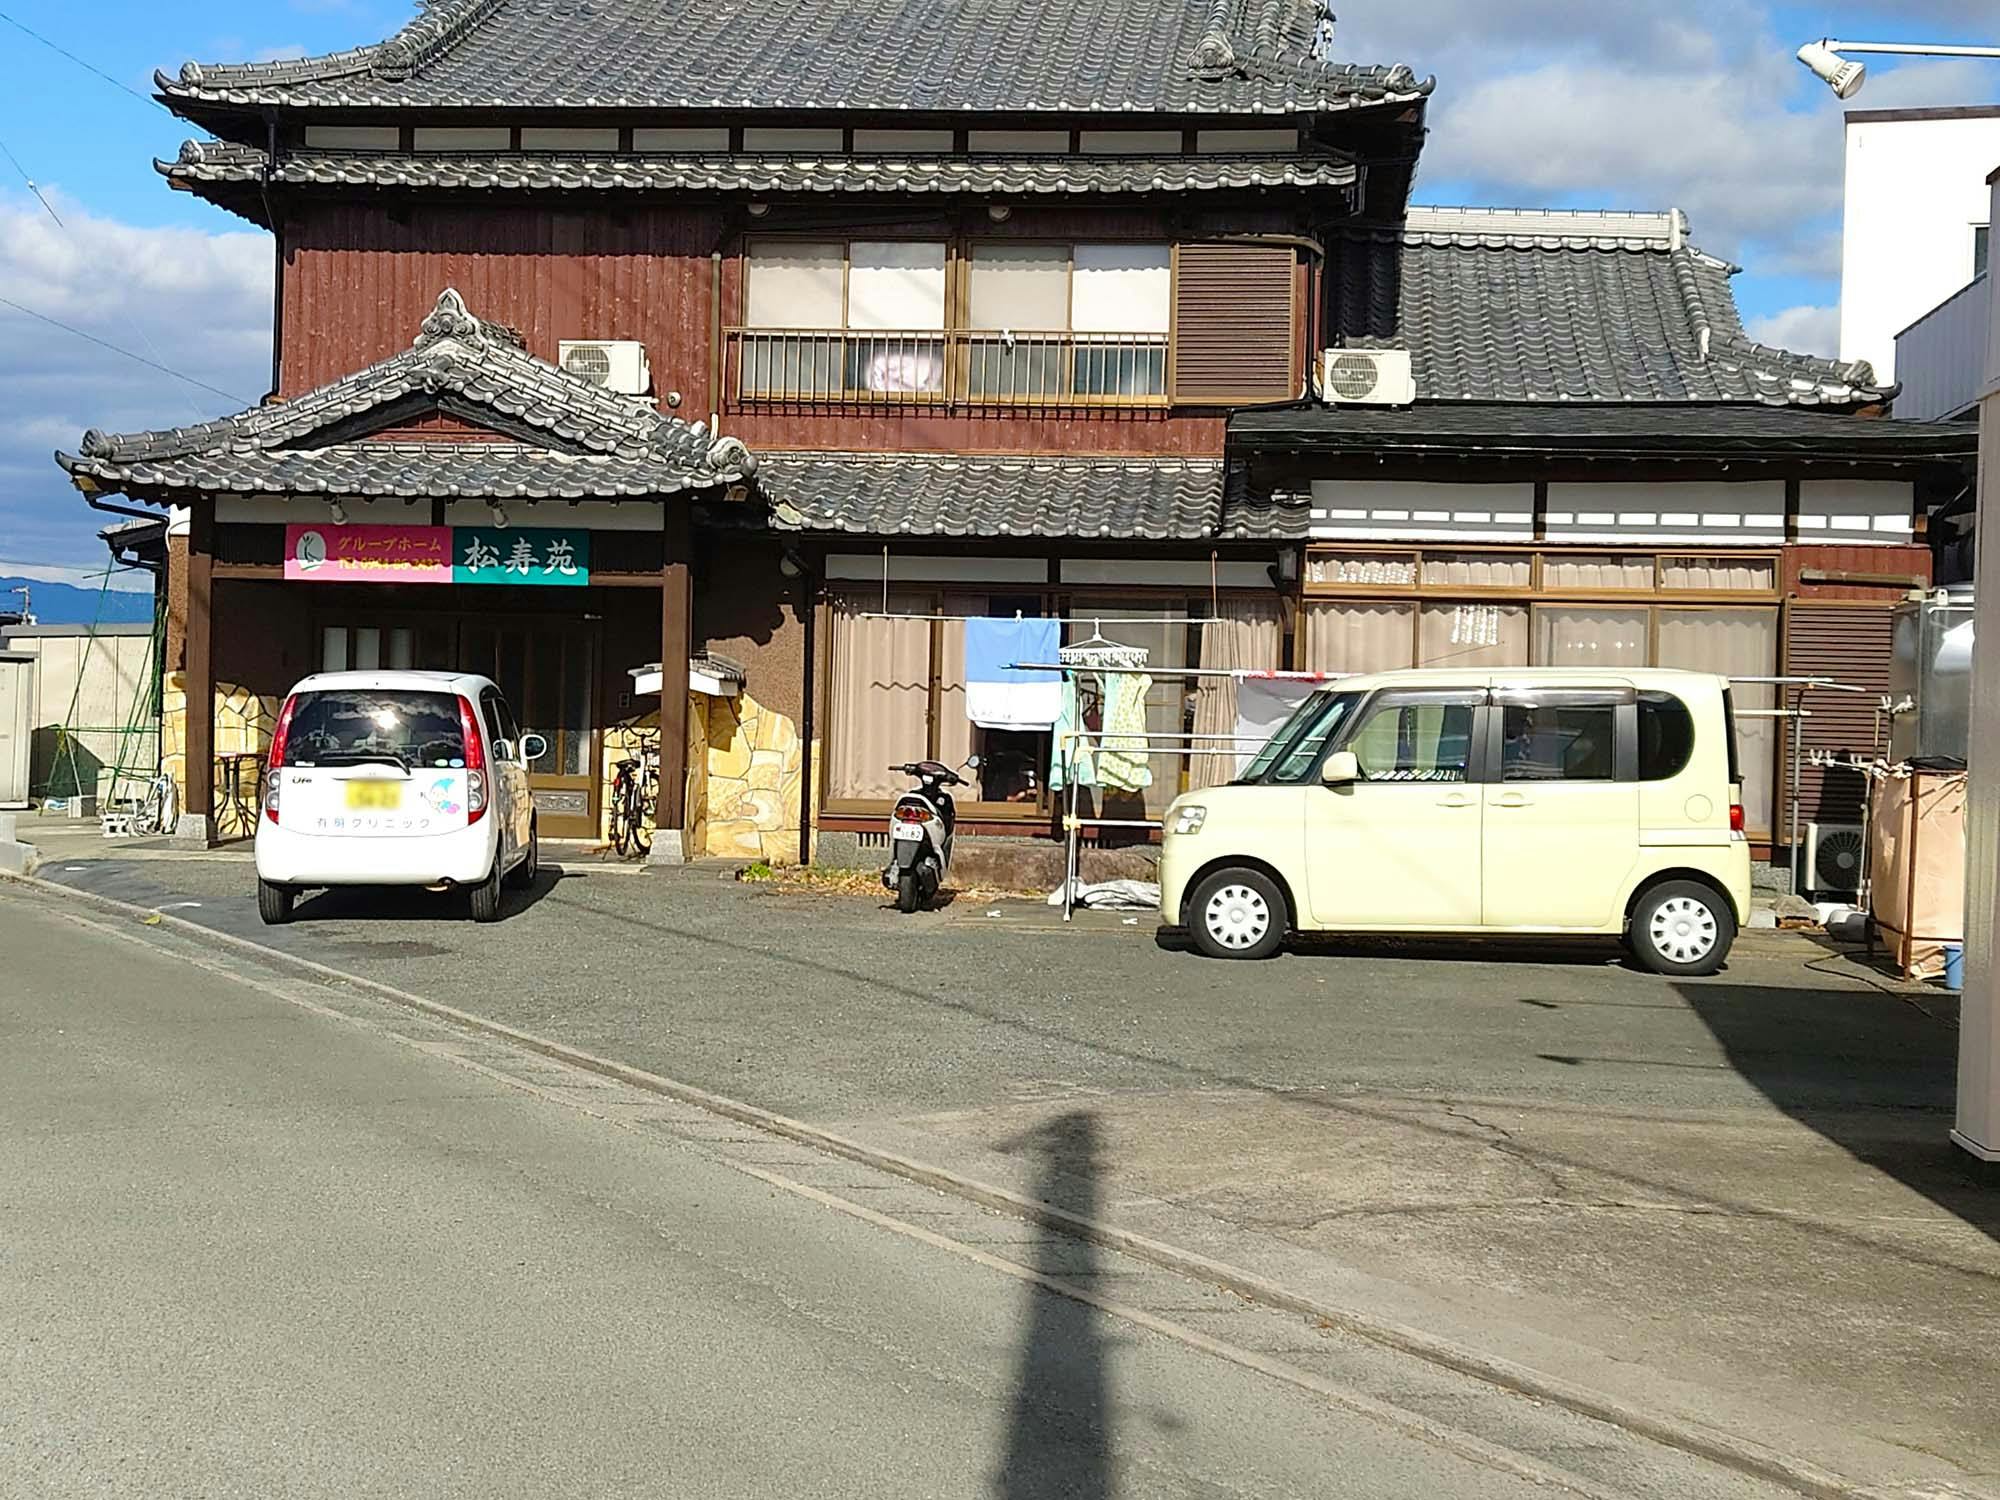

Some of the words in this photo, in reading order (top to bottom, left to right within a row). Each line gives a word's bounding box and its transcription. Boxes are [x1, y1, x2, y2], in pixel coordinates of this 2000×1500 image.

[337, 536, 442, 553] グループホーム
[338, 556, 358, 569] TEL
[464, 535, 577, 575] 松寿苑
